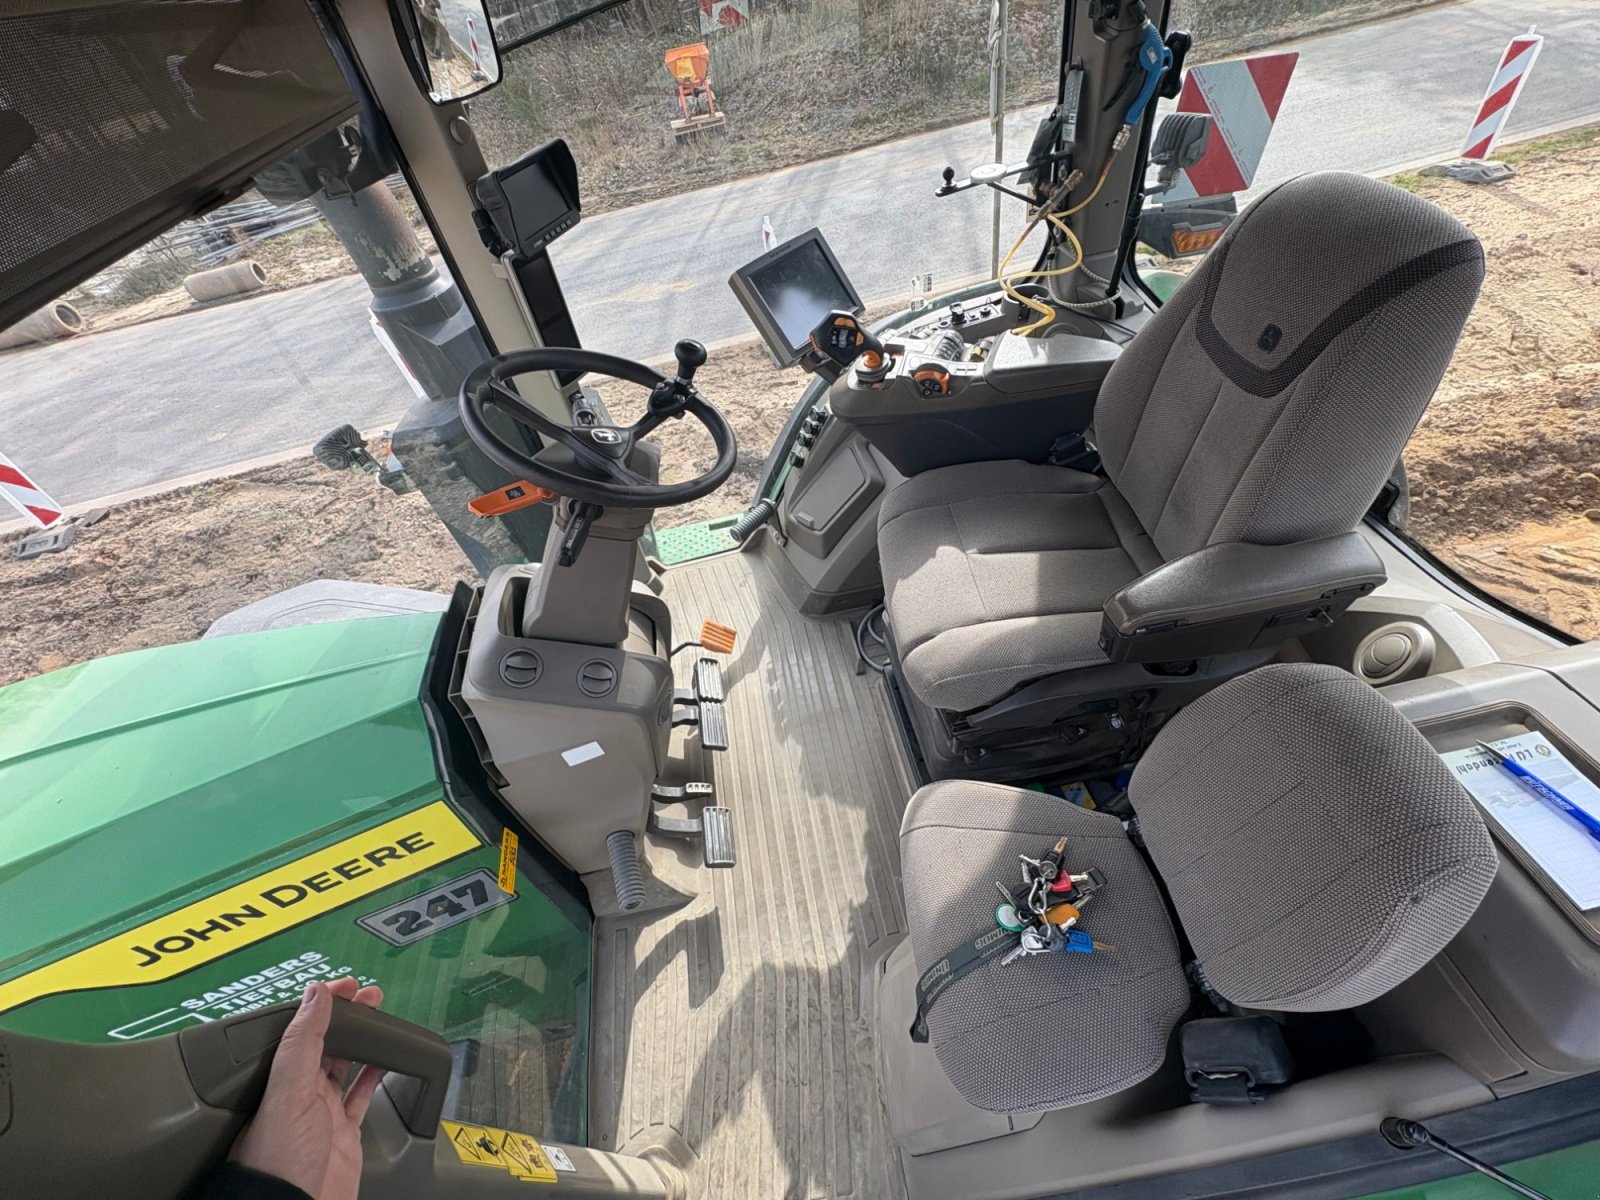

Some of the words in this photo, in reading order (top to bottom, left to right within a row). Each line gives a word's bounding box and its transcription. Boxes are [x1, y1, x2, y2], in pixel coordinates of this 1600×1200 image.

[130, 904, 267, 967] JOHN
[259, 831, 435, 909] DEERE
[382, 877, 490, 938] 247
[180, 951, 323, 1009] SANDERS
[212, 963, 331, 1011] TIEFBAU
[277, 991, 293, 999] &
